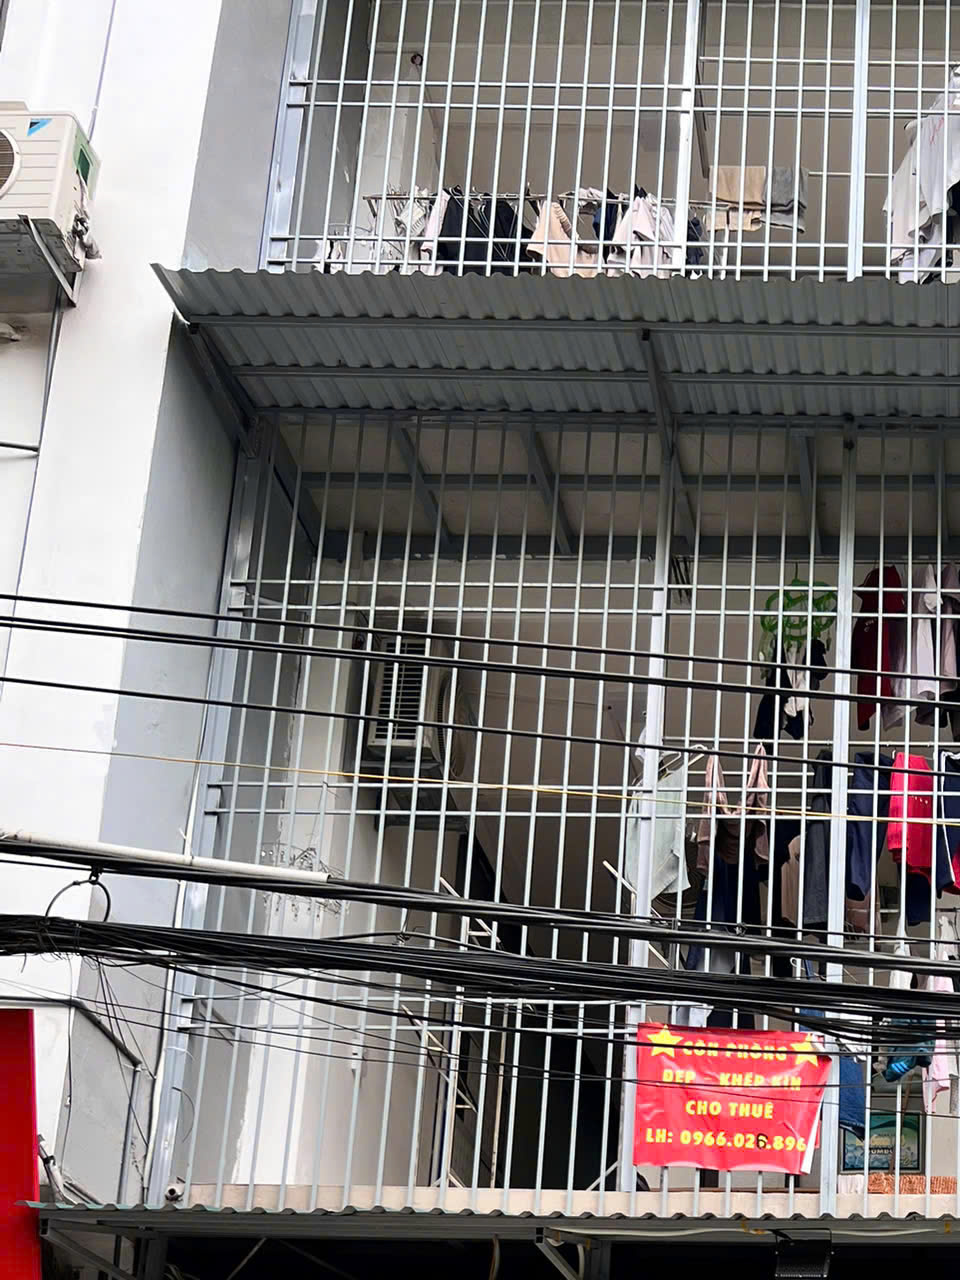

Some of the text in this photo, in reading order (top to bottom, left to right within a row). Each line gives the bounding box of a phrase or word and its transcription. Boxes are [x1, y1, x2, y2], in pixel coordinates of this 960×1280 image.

[685, 1100, 775, 1119] CHO THUÊ
[645, 1128, 673, 1143] LH:
